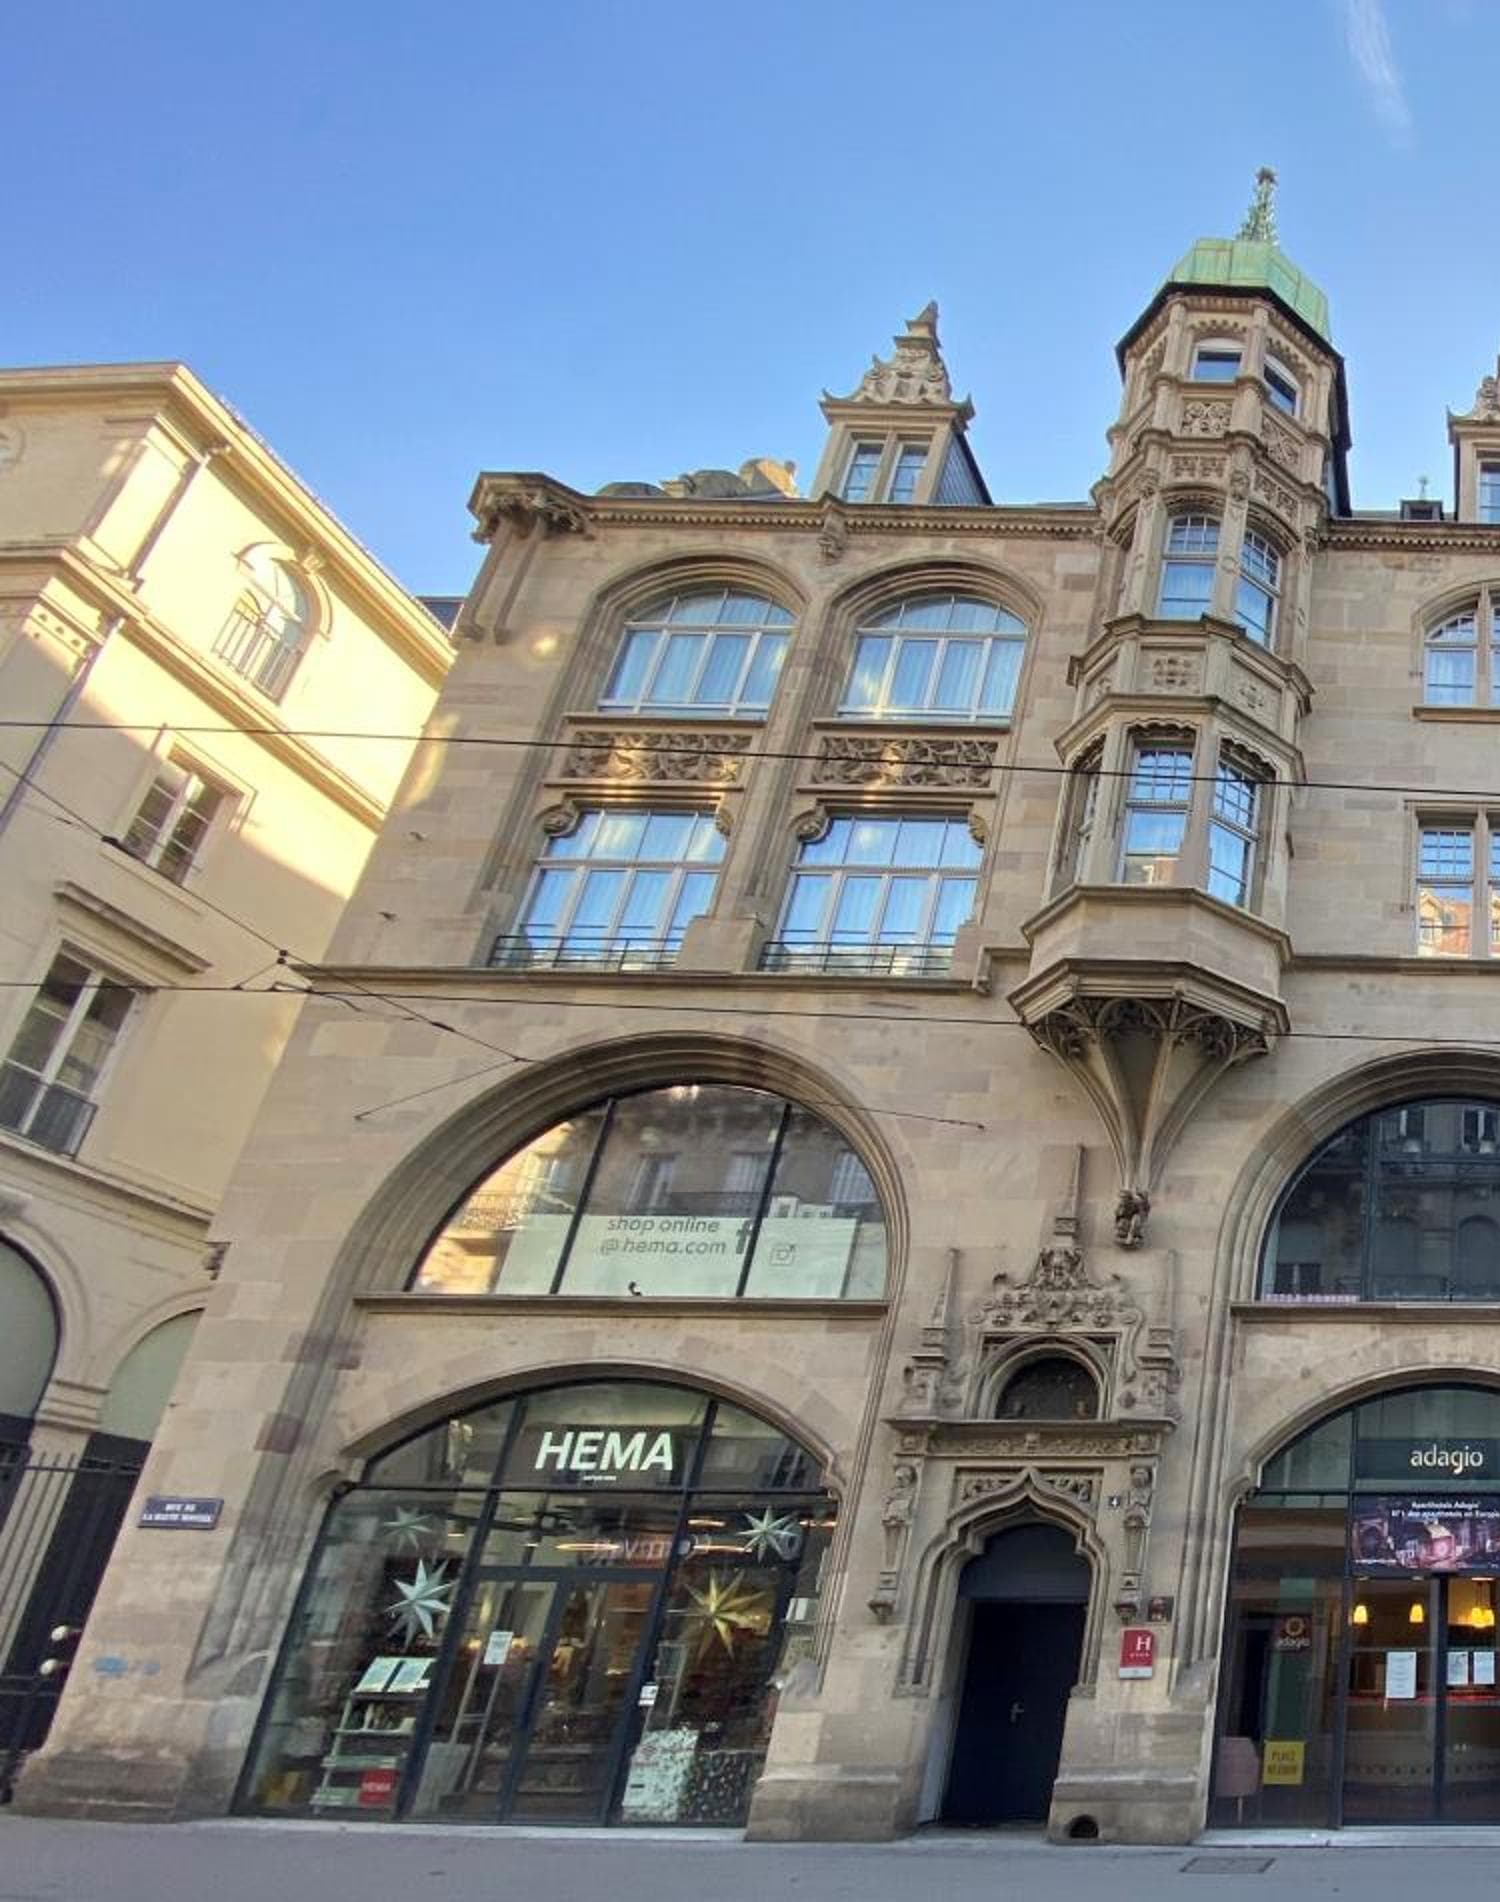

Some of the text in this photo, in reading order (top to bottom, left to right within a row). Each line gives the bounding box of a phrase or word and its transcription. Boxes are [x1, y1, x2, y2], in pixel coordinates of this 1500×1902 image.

[607, 1217, 721, 1235] shop online
[534, 1431, 674, 1471] HEMA
[1410, 1443, 1484, 1474] adagio
[1136, 1636, 1152, 1651] H
